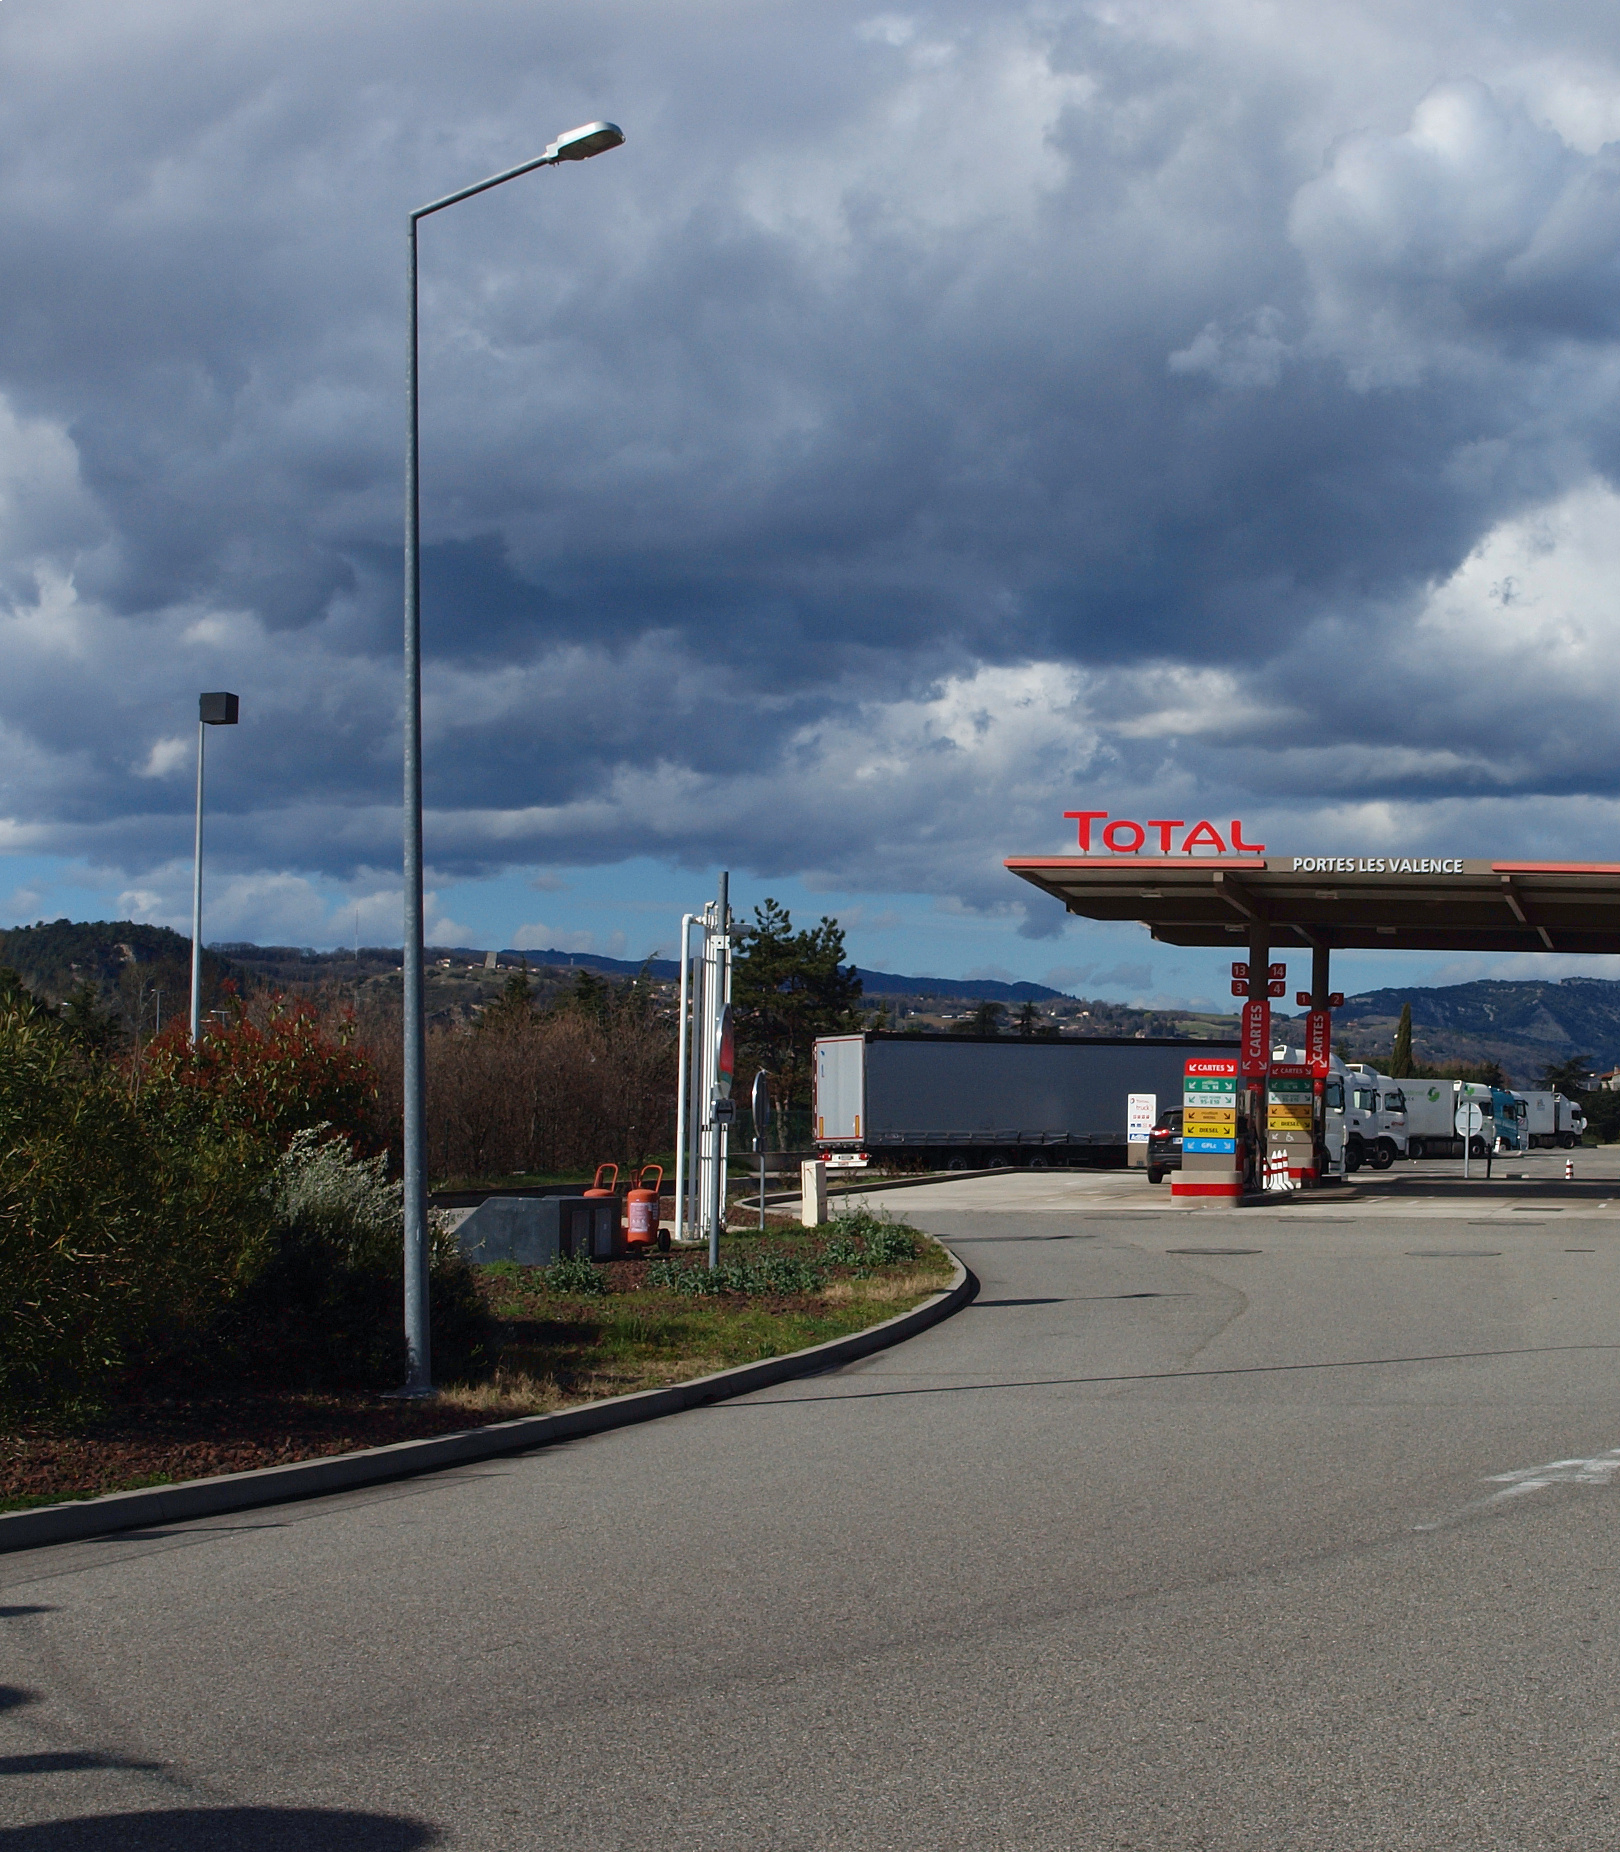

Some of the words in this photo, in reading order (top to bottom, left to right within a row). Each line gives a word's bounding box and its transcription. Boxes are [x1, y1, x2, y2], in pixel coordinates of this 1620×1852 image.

[1063, 811, 1266, 853] TOTAL
[1293, 857, 1355, 873] PORTES
[1359, 858, 1386, 873] LES
[1389, 858, 1464, 874] VALENCE
[1233, 965, 1246, 976] 13
[1272, 966, 1284, 977] 14
[1236, 983, 1243, 994] 3
[1273, 984, 1281, 994] 4
[1249, 1004, 1263, 1058] CARTES
[1313, 1014, 1324, 1061] CARTES
[1197, 1064, 1225, 1072] CARTES
